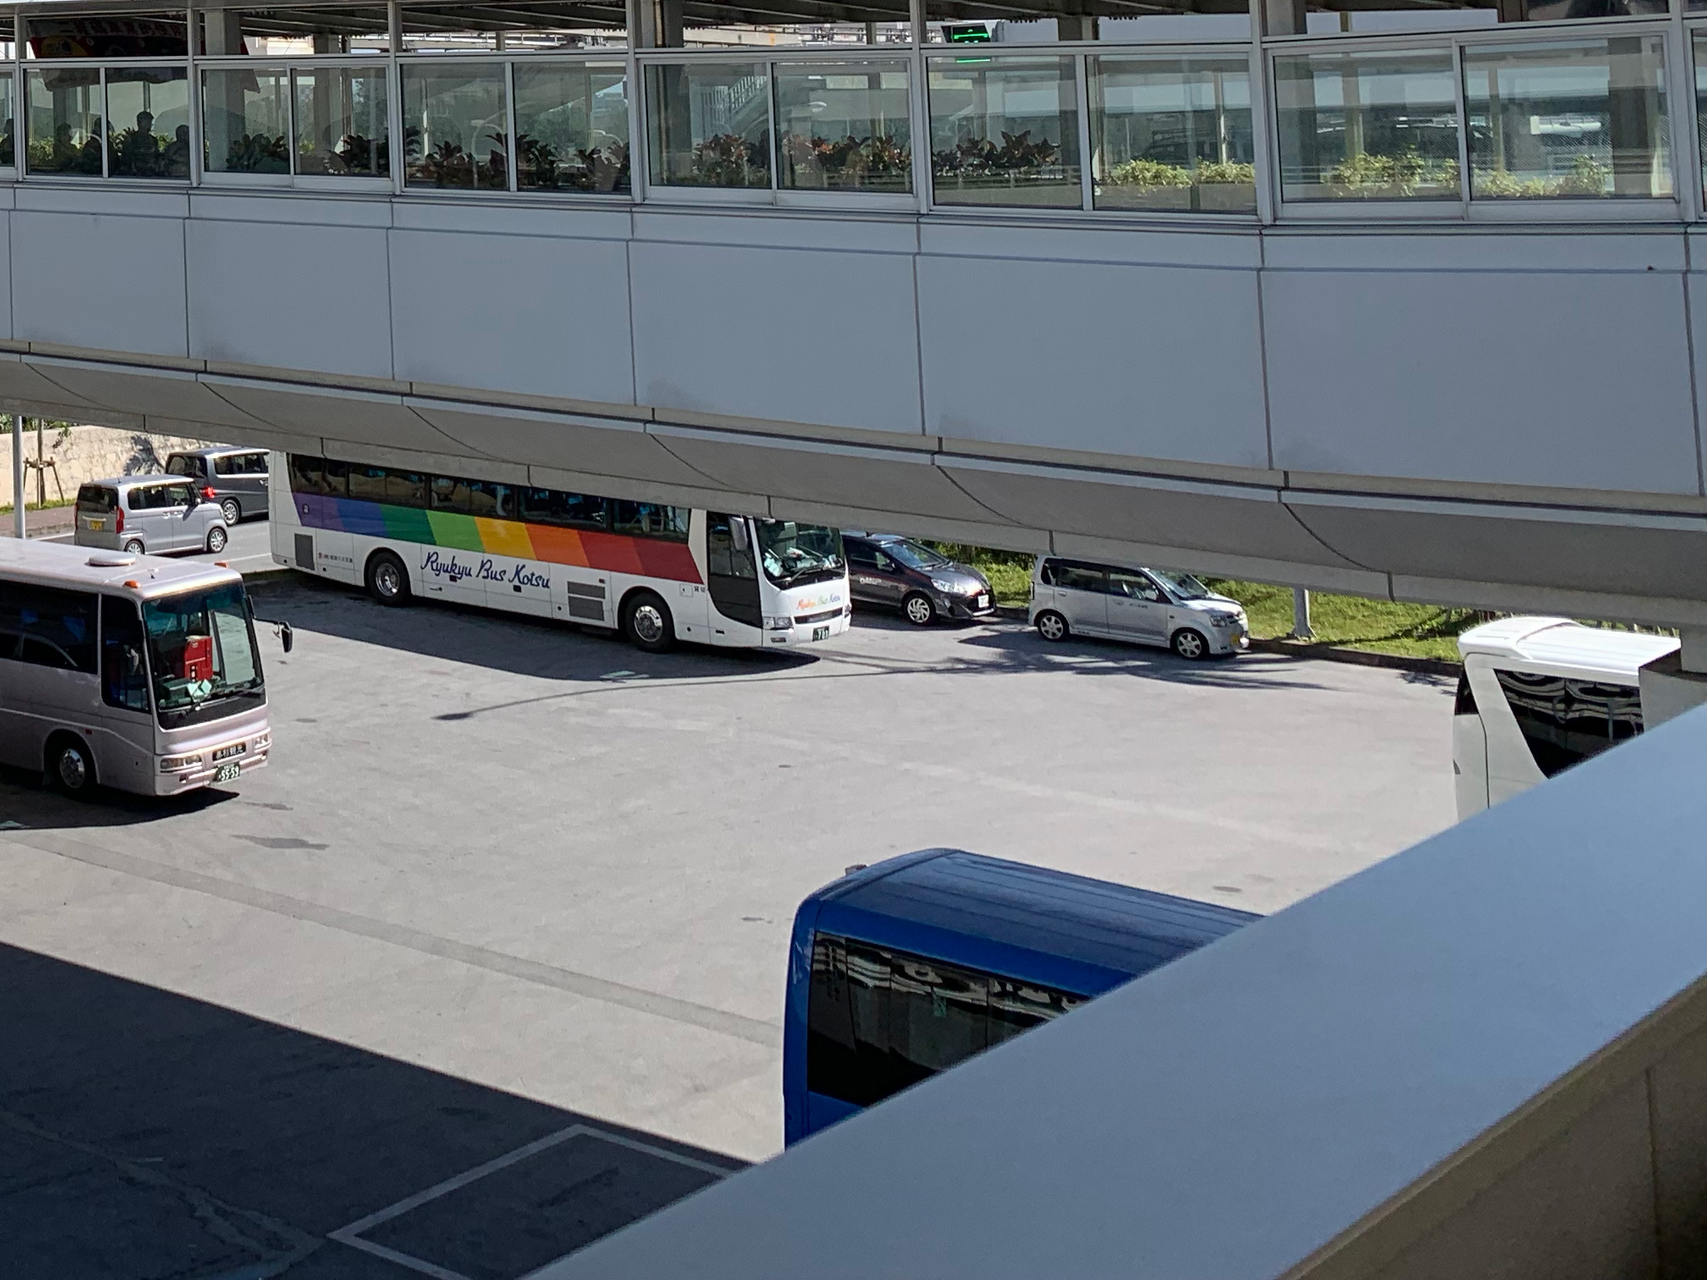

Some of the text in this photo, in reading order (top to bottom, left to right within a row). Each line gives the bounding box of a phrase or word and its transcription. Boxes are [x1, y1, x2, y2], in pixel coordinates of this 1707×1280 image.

[421, 551, 551, 589] Ryukyu Bus Kotsu
